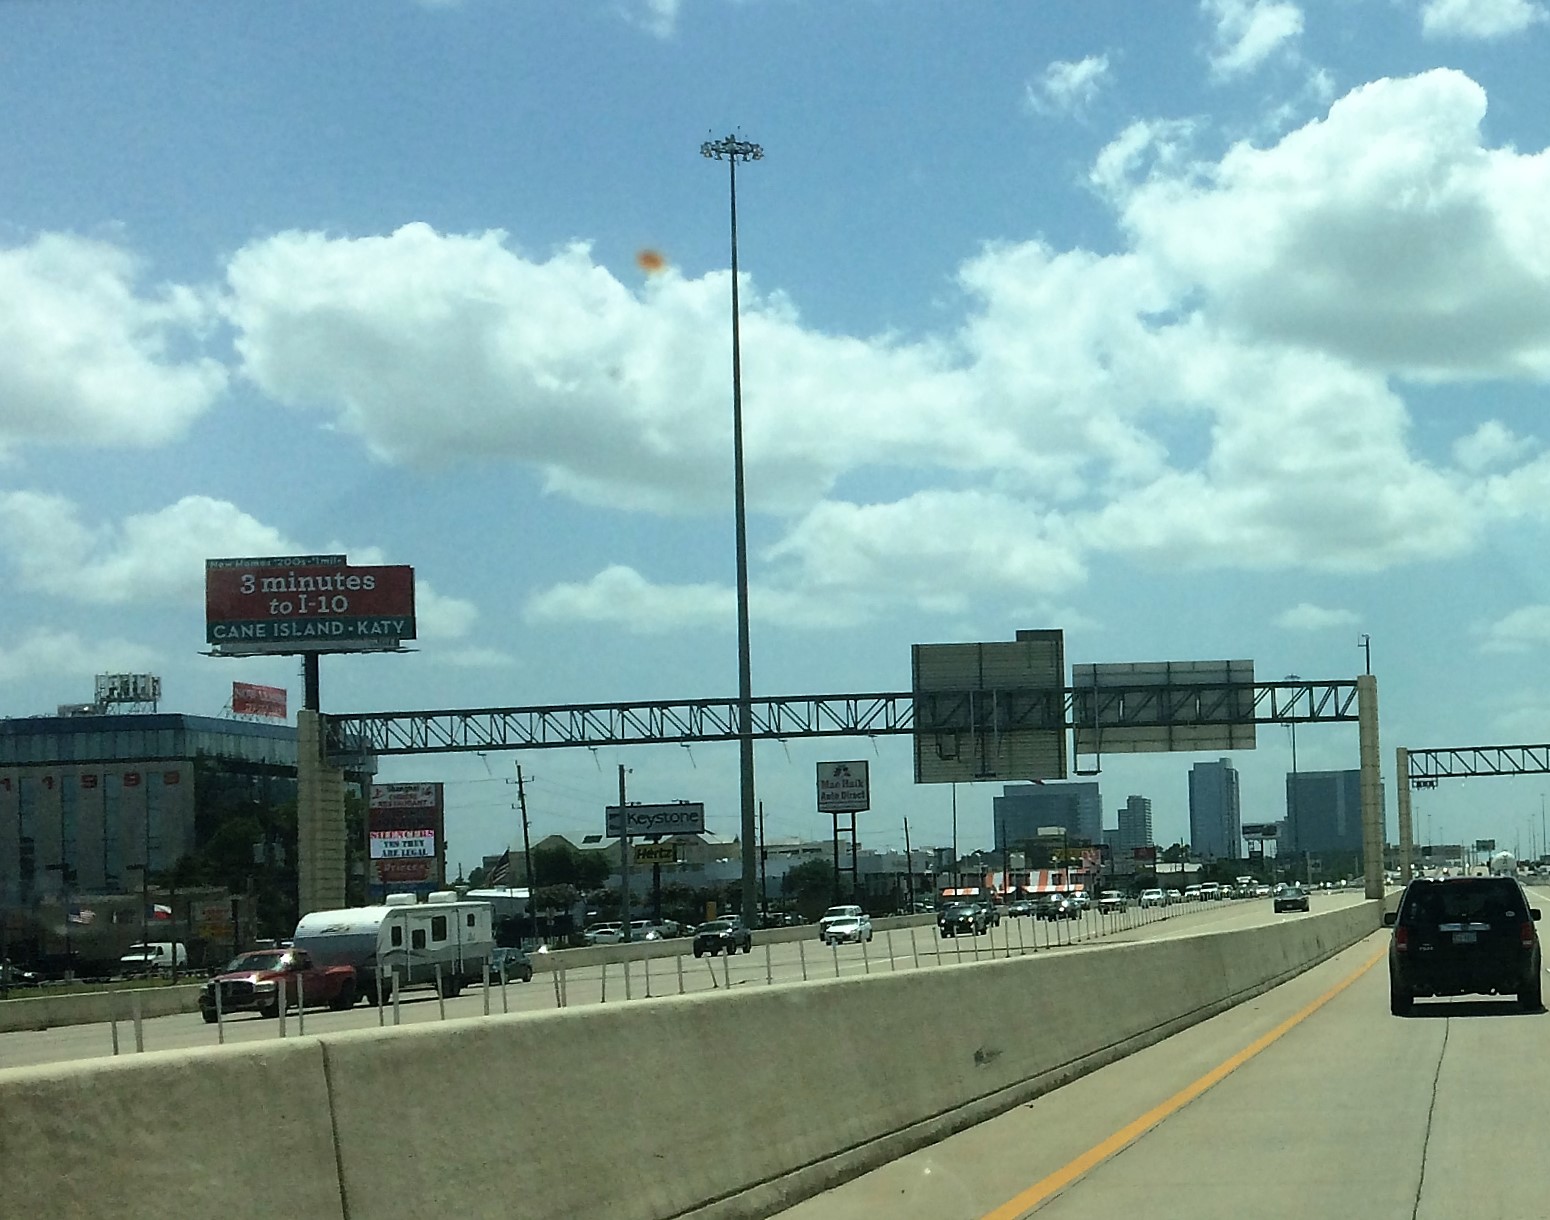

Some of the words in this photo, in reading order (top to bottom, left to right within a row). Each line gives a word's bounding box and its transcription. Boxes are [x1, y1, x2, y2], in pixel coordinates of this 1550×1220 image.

[240, 574, 255, 594] 3
[261, 571, 376, 593] minutes
[269, 598, 293, 615] to
[298, 594, 348, 614] I-10
[213, 623, 266, 639] CANE
[273, 621, 344, 637] ISLAND
[357, 620, 405, 635] KATY
[820, 791, 840, 800] Auto
[841, 790, 865, 799] Direct
[627, 811, 699, 829] Keystone
[636, 847, 673, 859] Hertz
